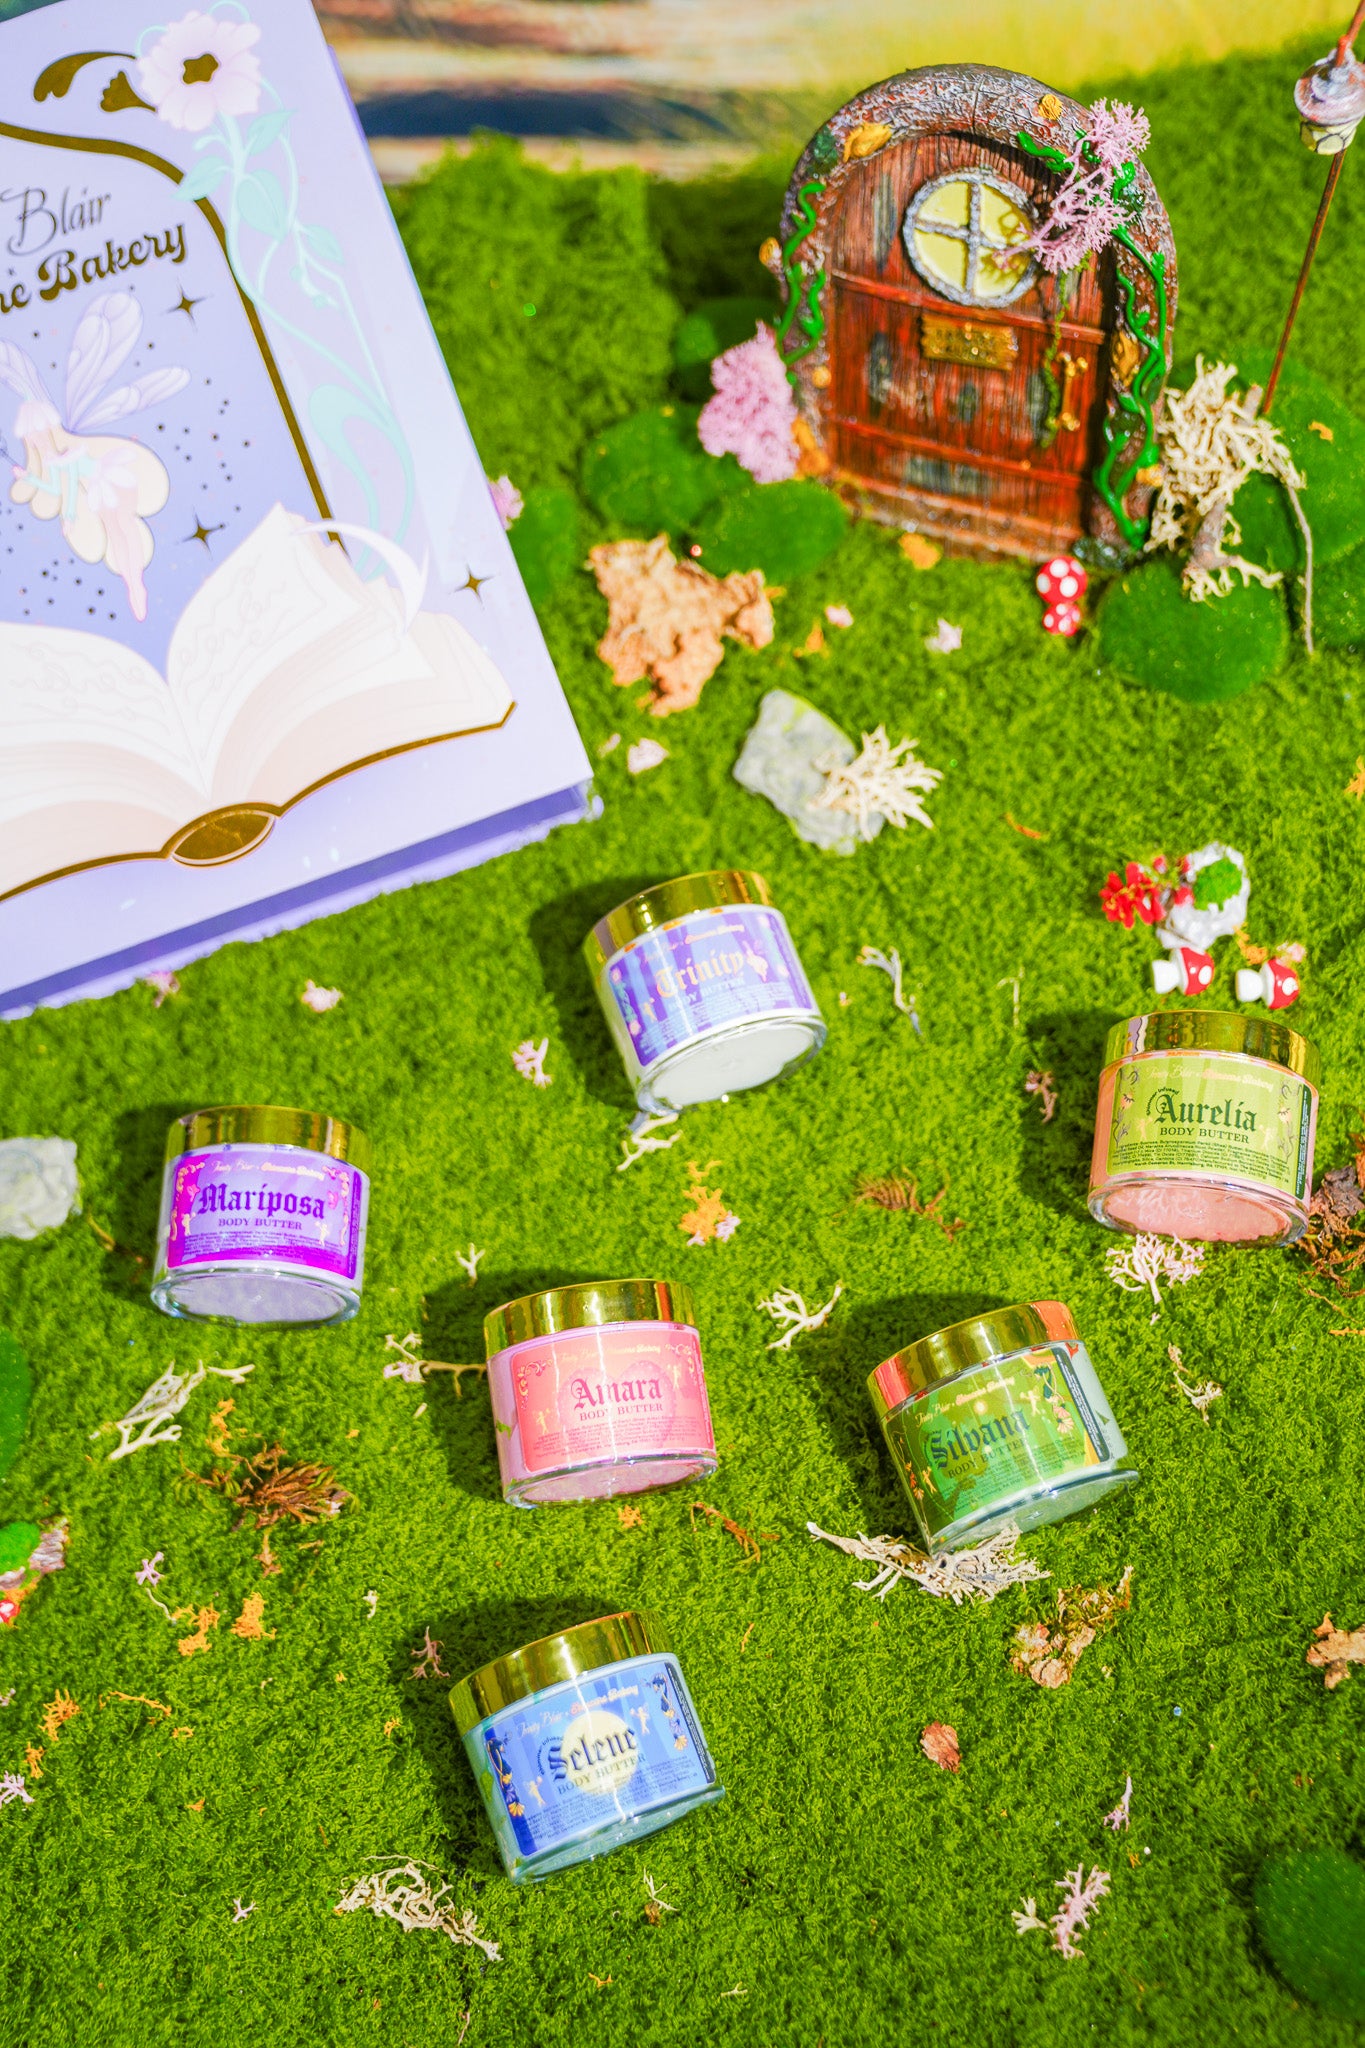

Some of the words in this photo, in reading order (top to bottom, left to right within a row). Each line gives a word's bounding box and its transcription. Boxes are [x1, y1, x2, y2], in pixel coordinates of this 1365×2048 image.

[0, 186, 111, 256] Blair
[38, 223, 187, 302] Bakery
[656, 950, 744, 998] Trinity
[1154, 1093, 1257, 1132] Aurelia
[1160, 1127, 1195, 1136] BODY
[1200, 1128, 1250, 1144] BUTTER
[198, 1183, 325, 1219] Mariposa
[219, 1218, 250, 1227] BODY
[255, 1218, 302, 1230] BUTTER
[571, 1377, 663, 1411] Amara
[617, 1404, 663, 1415] BUTTER
[925, 1410, 1030, 1470] Silvana
[547, 1728, 637, 1782] Selene
[558, 1773, 591, 1795] BODY
[596, 1753, 647, 1778] BUTTER
